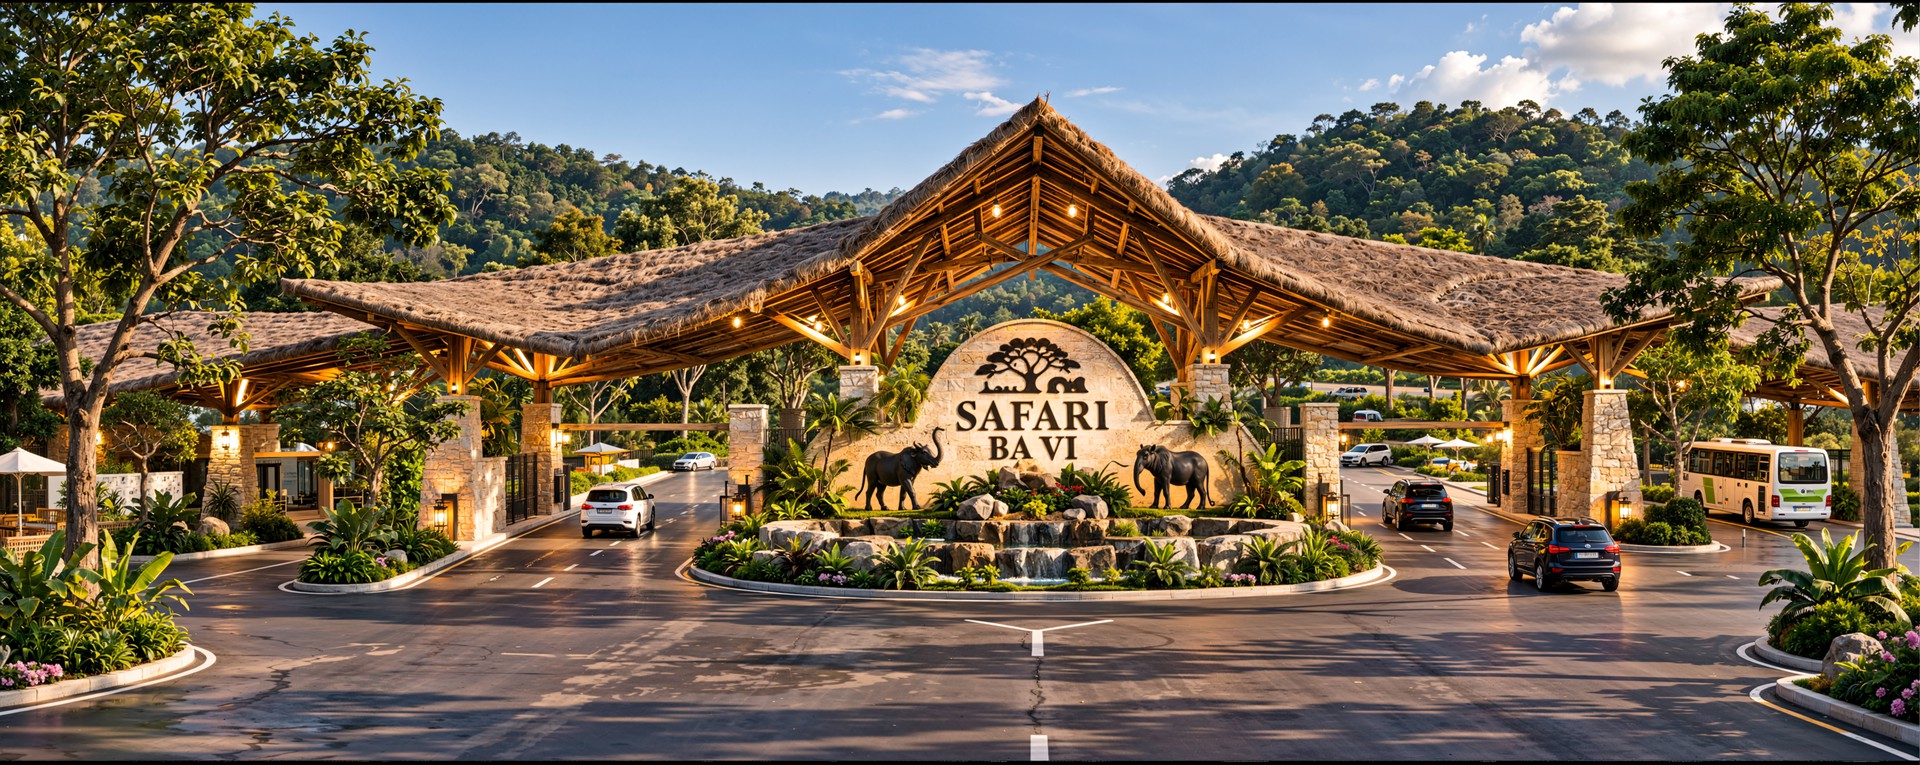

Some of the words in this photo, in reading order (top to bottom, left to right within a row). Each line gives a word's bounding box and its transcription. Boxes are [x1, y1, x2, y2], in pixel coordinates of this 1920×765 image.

[956, 400, 1109, 431] SAFARI
[989, 435, 1033, 460] BA
[1039, 436, 1077, 461] VI
